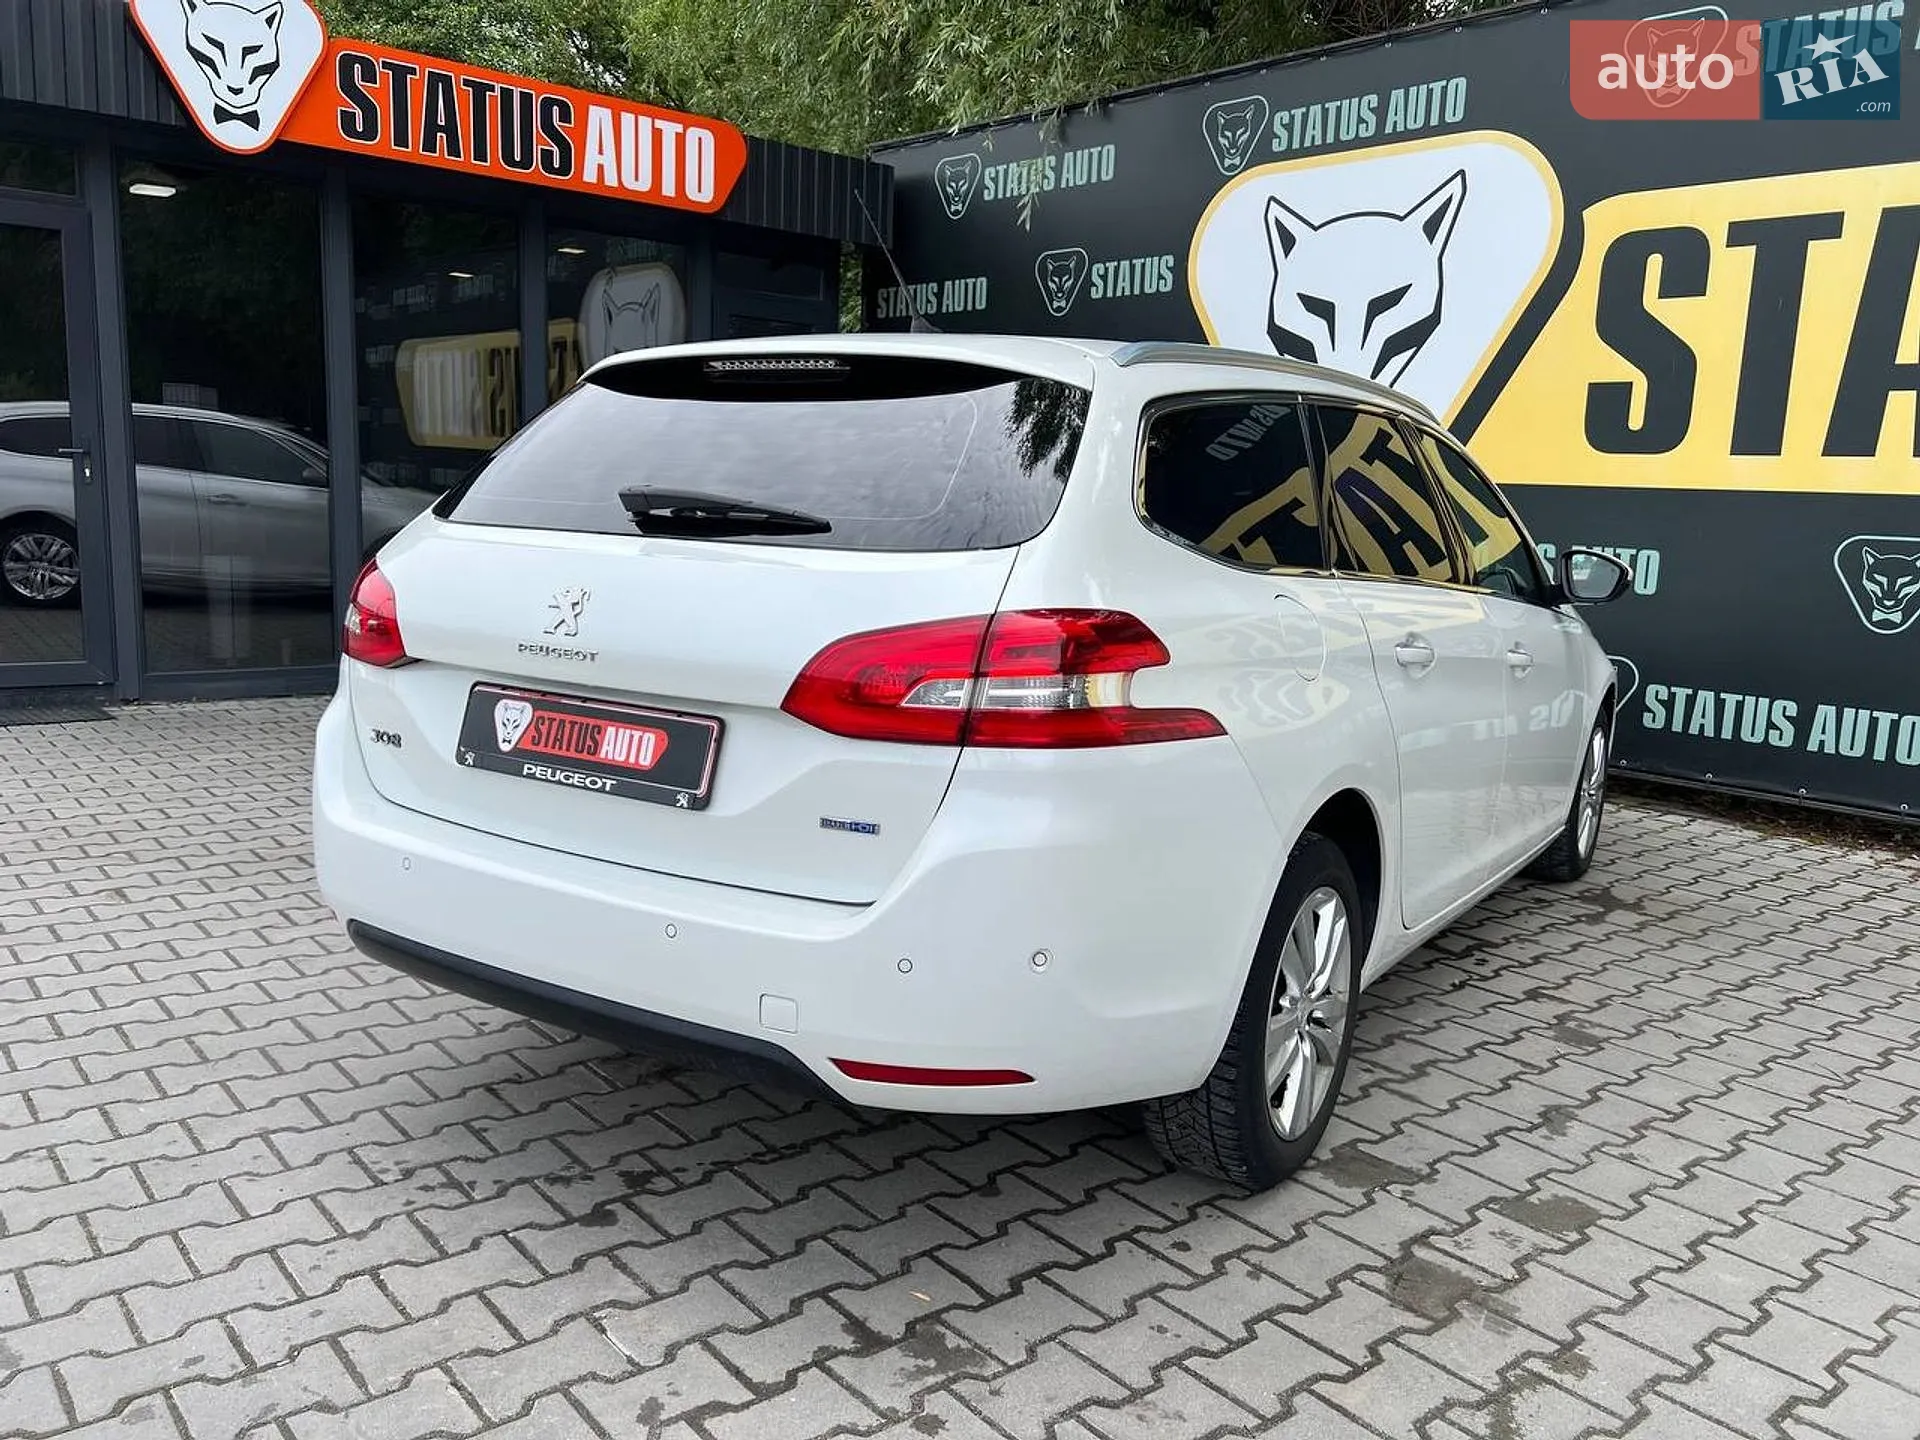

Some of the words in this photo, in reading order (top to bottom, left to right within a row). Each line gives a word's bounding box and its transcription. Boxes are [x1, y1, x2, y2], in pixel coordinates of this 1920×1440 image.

[336, 52, 574, 179] STATUS
[582, 105, 715, 203] AUTO
[1272, 94, 1379, 153] STATUS
[1384, 77, 1467, 131] AUTO
[983, 156, 1057, 201] STATUS
[1061, 144, 1116, 188] AUTO
[876, 282, 938, 319] STATUS
[942, 276, 988, 313] AUTO
[1090, 254, 1175, 299] STATUS
[518, 643, 599, 662] PEUGEOT
[370, 729, 402, 749] 308
[531, 714, 600, 756] STATUS
[600, 725, 657, 767] AUTO
[1642, 683, 1798, 747] STATUS
[1806, 704, 1920, 766] AUTO
[522, 764, 617, 793] PEUGEOT
